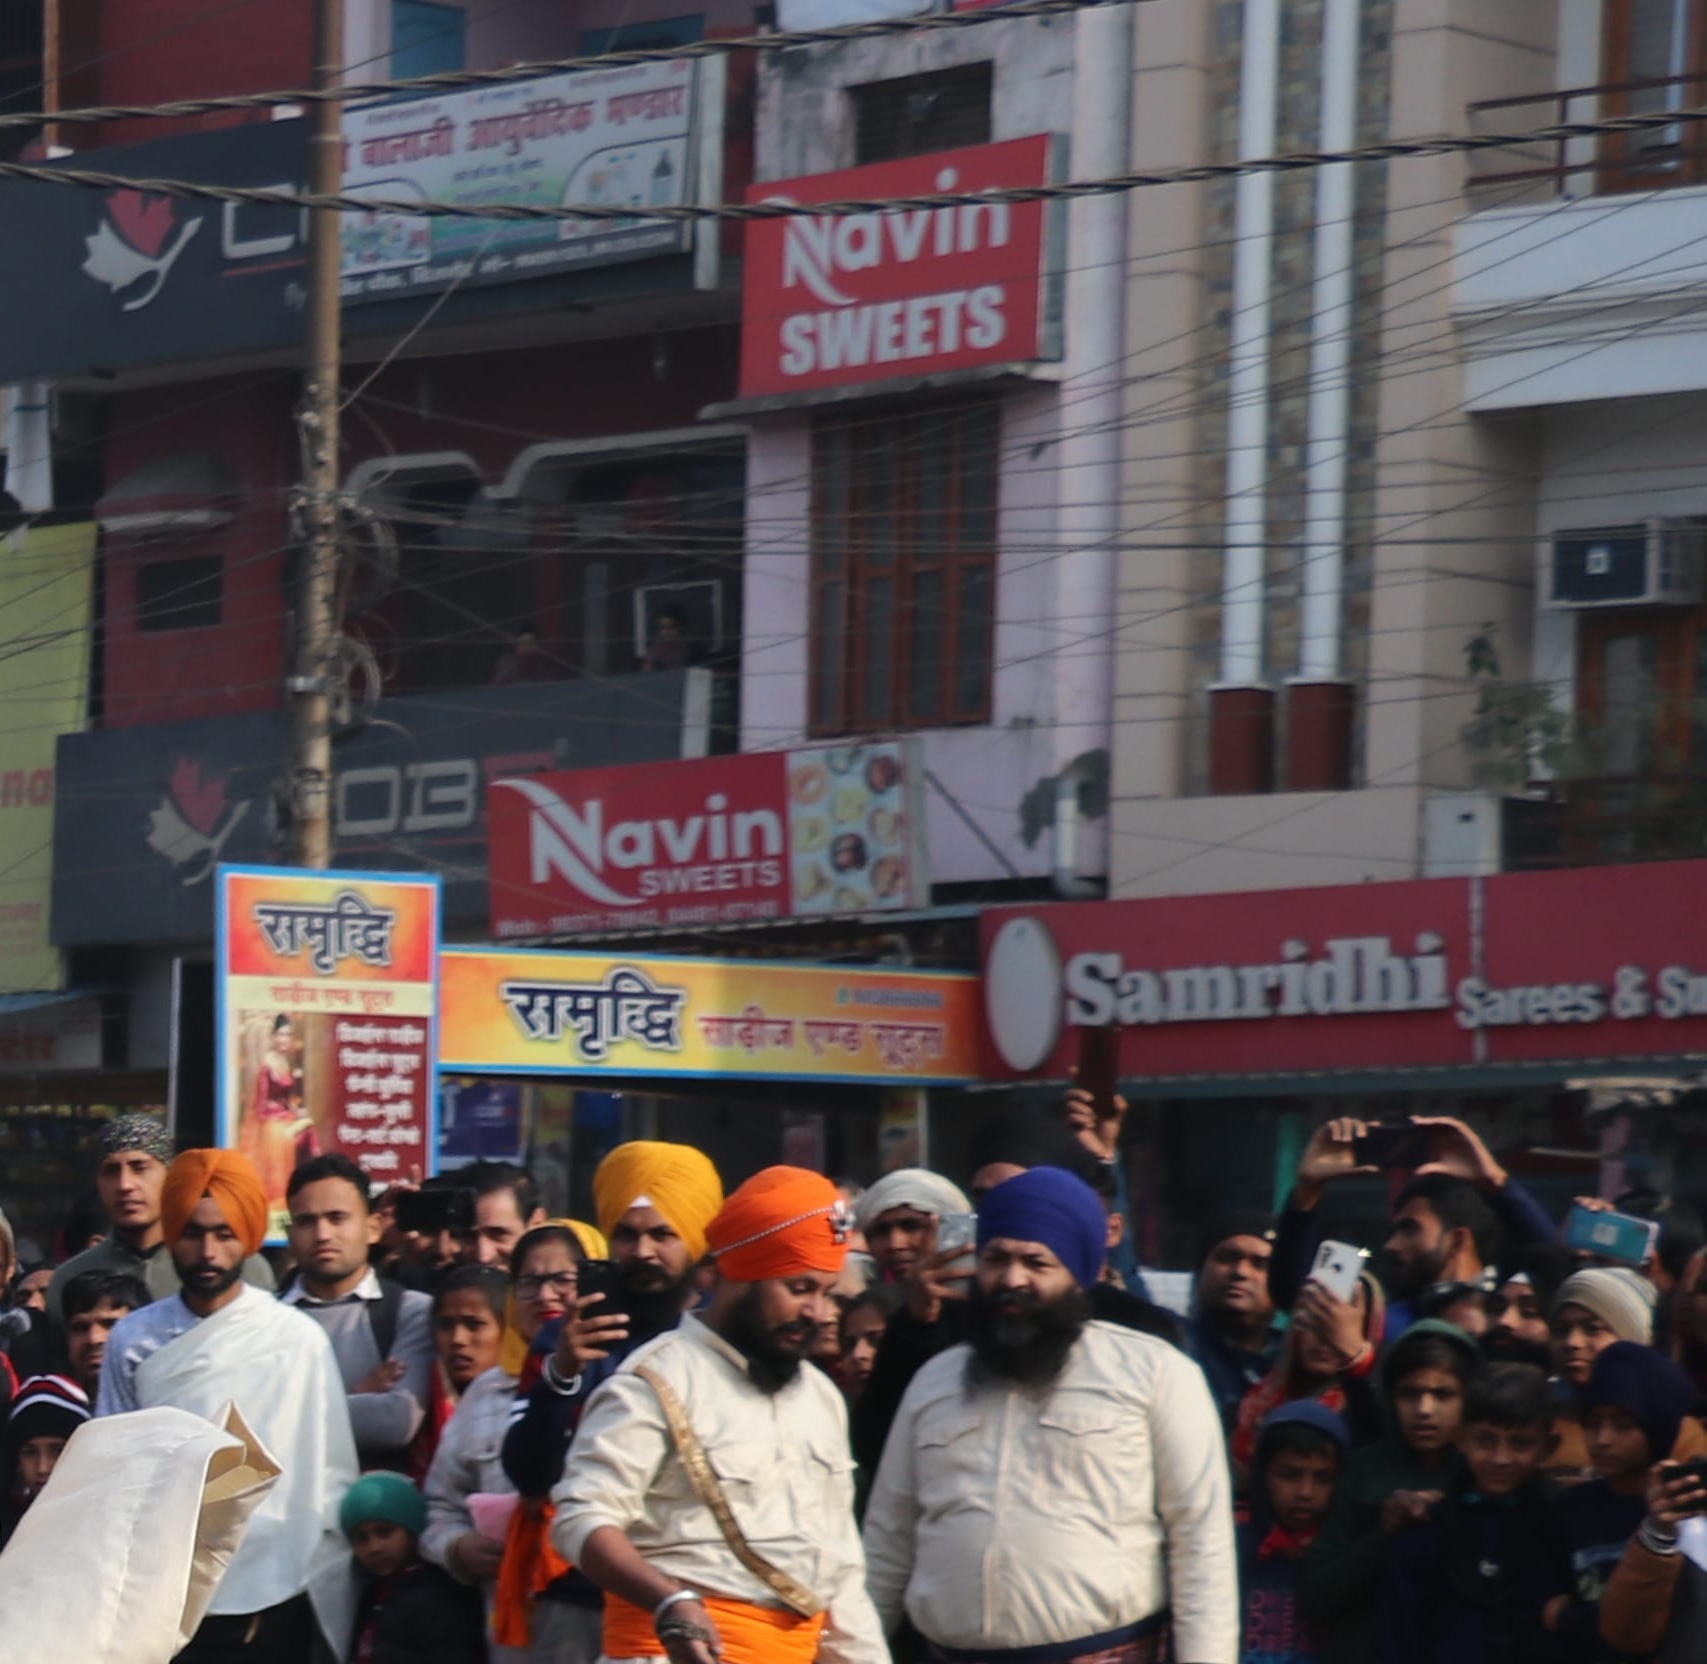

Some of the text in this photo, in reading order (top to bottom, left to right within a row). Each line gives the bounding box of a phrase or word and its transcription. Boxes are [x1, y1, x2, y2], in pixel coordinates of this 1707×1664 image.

[758, 166, 1011, 308] Navin
[780, 285, 1007, 378] SWEETS
[490, 778, 786, 907] Navin
[638, 859, 782, 898] SWEETS
[253, 887, 396, 975] समृद्धि
[1065, 930, 1452, 1028] Samridhi
[1455, 975, 1608, 1030] Sarees
[1612, 964, 1653, 1019] &
[501, 964, 686, 1062] समृद्धि
